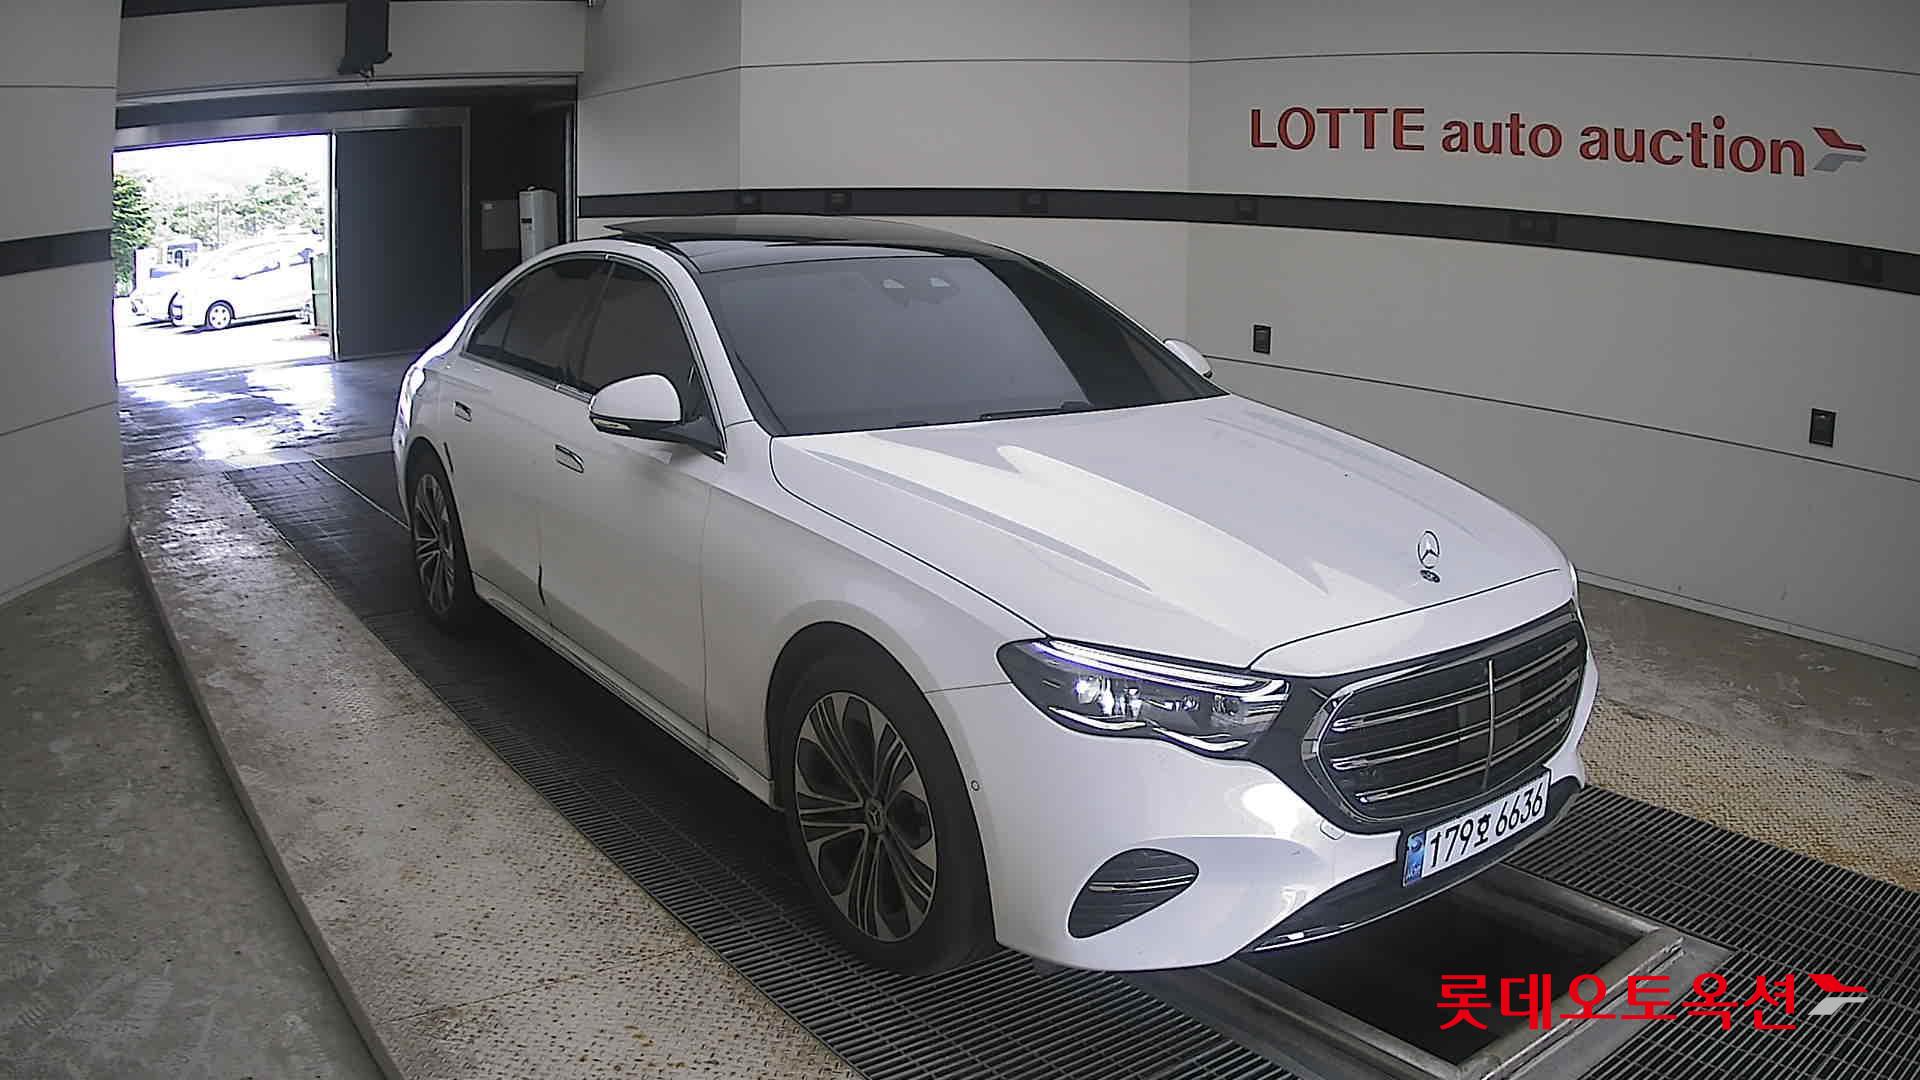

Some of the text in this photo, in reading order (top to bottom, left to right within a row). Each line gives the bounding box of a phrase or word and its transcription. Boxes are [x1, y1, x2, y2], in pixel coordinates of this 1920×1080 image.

[1250, 107, 1805, 177] LOTTE auto auction
[1430, 782, 1544, 868] 179호 6636
